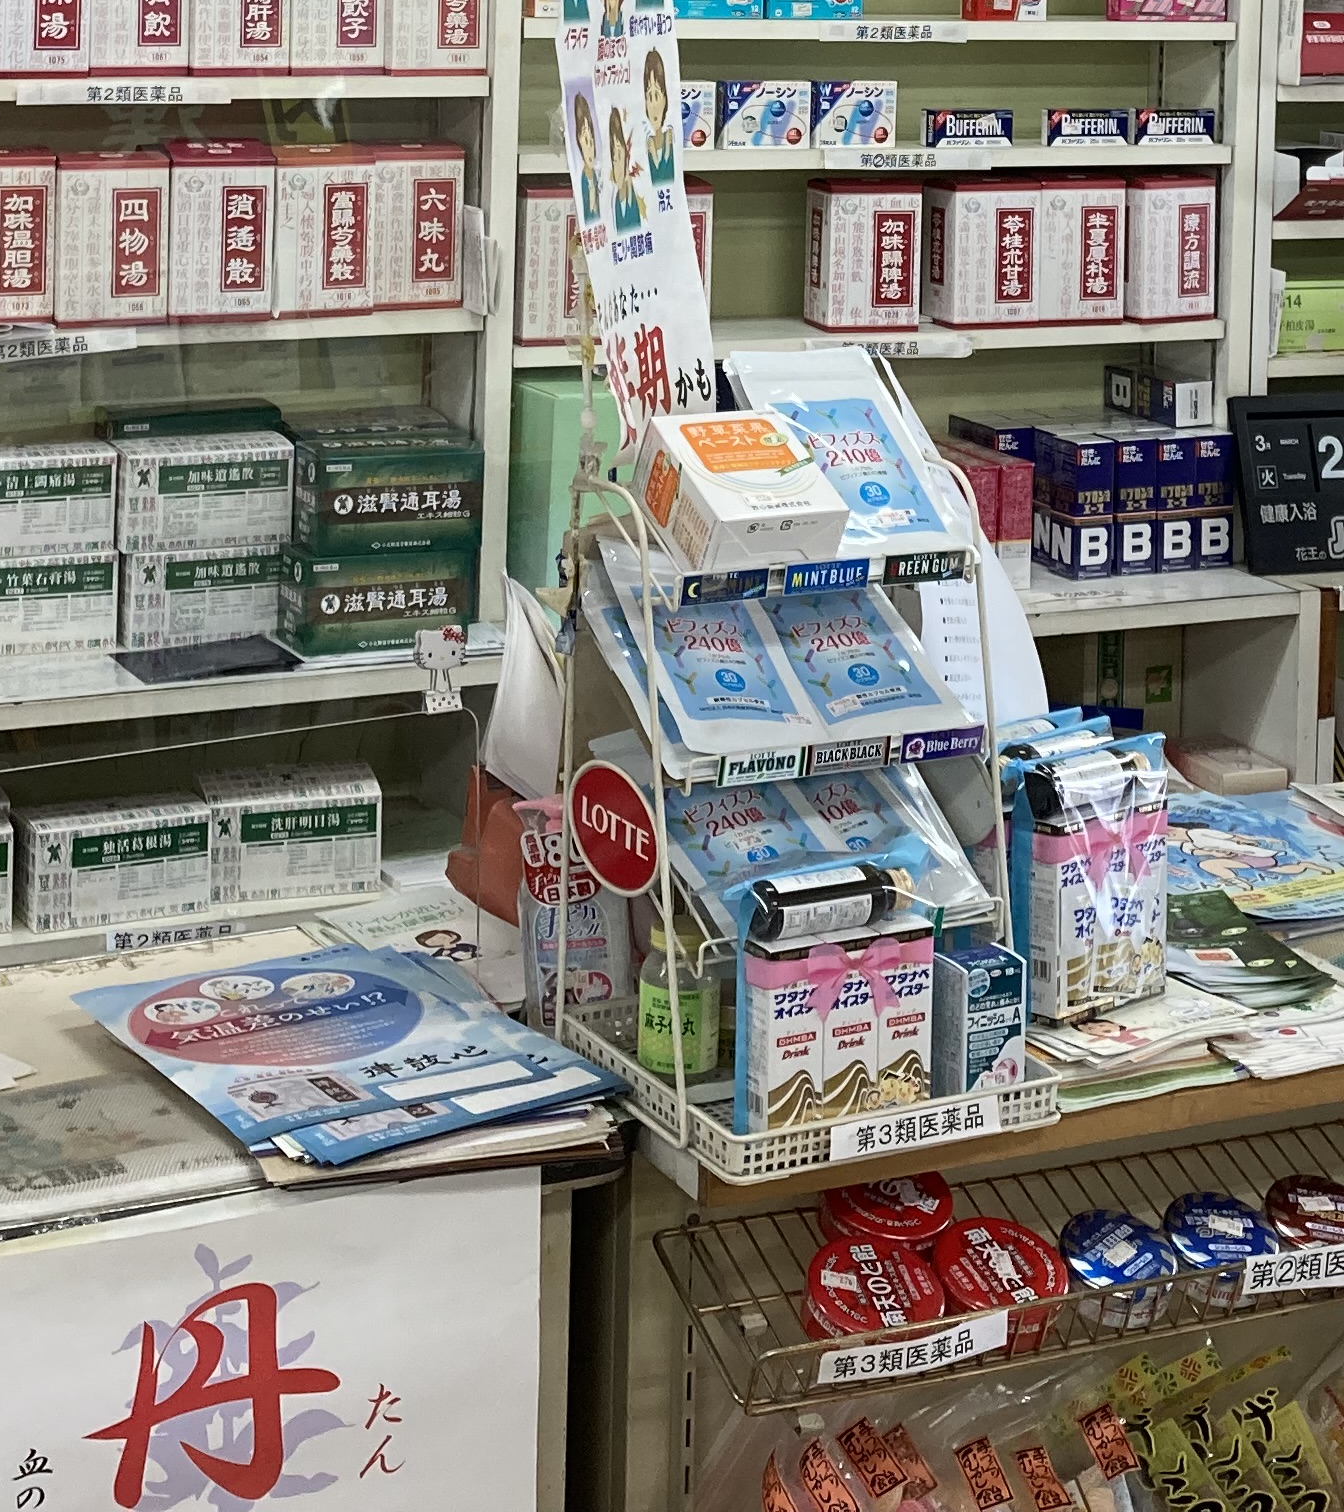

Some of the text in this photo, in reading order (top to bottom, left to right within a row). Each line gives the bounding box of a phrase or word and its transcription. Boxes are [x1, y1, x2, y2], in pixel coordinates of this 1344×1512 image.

[855, 25, 933, 41] 第2類医薬品
[86, 85, 184, 103] 第2類医薬品
[117, 198, 150, 288] 四物湯
[417, 187, 447, 275] 六味丸
[1259, 502, 1318, 524] 健康入浴
[727, 754, 797, 779] FLAVONO
[924, 732, 981, 755] Blue Berry
[580, 795, 651, 864] LOTTE
[855, 1103, 986, 1152] 第3類医薬品
[833, 1329, 976, 1379] 第3類医薬品
[81, 1281, 342, 1510] 丹
[359, 1381, 405, 1479] たん
